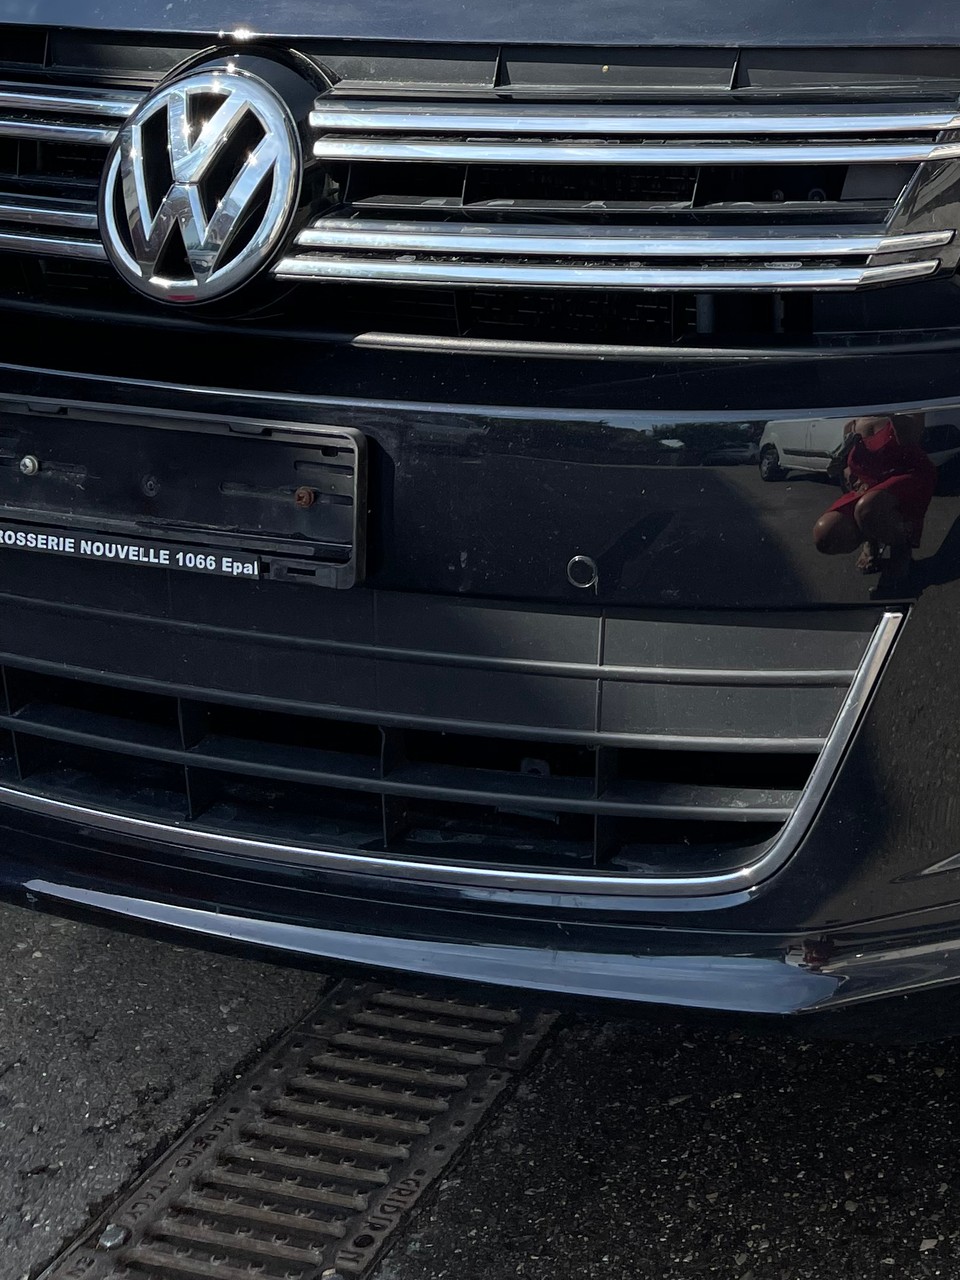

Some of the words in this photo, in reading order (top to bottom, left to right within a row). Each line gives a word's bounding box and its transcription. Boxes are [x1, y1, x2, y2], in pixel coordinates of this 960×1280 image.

[116, 82, 280, 286] VW
[80, 540, 170, 564] NOUVELLE
[176, 552, 216, 570] 1066
[222, 557, 259, 575] Epal
[338, 1178, 420, 1264] GRIDIRON
